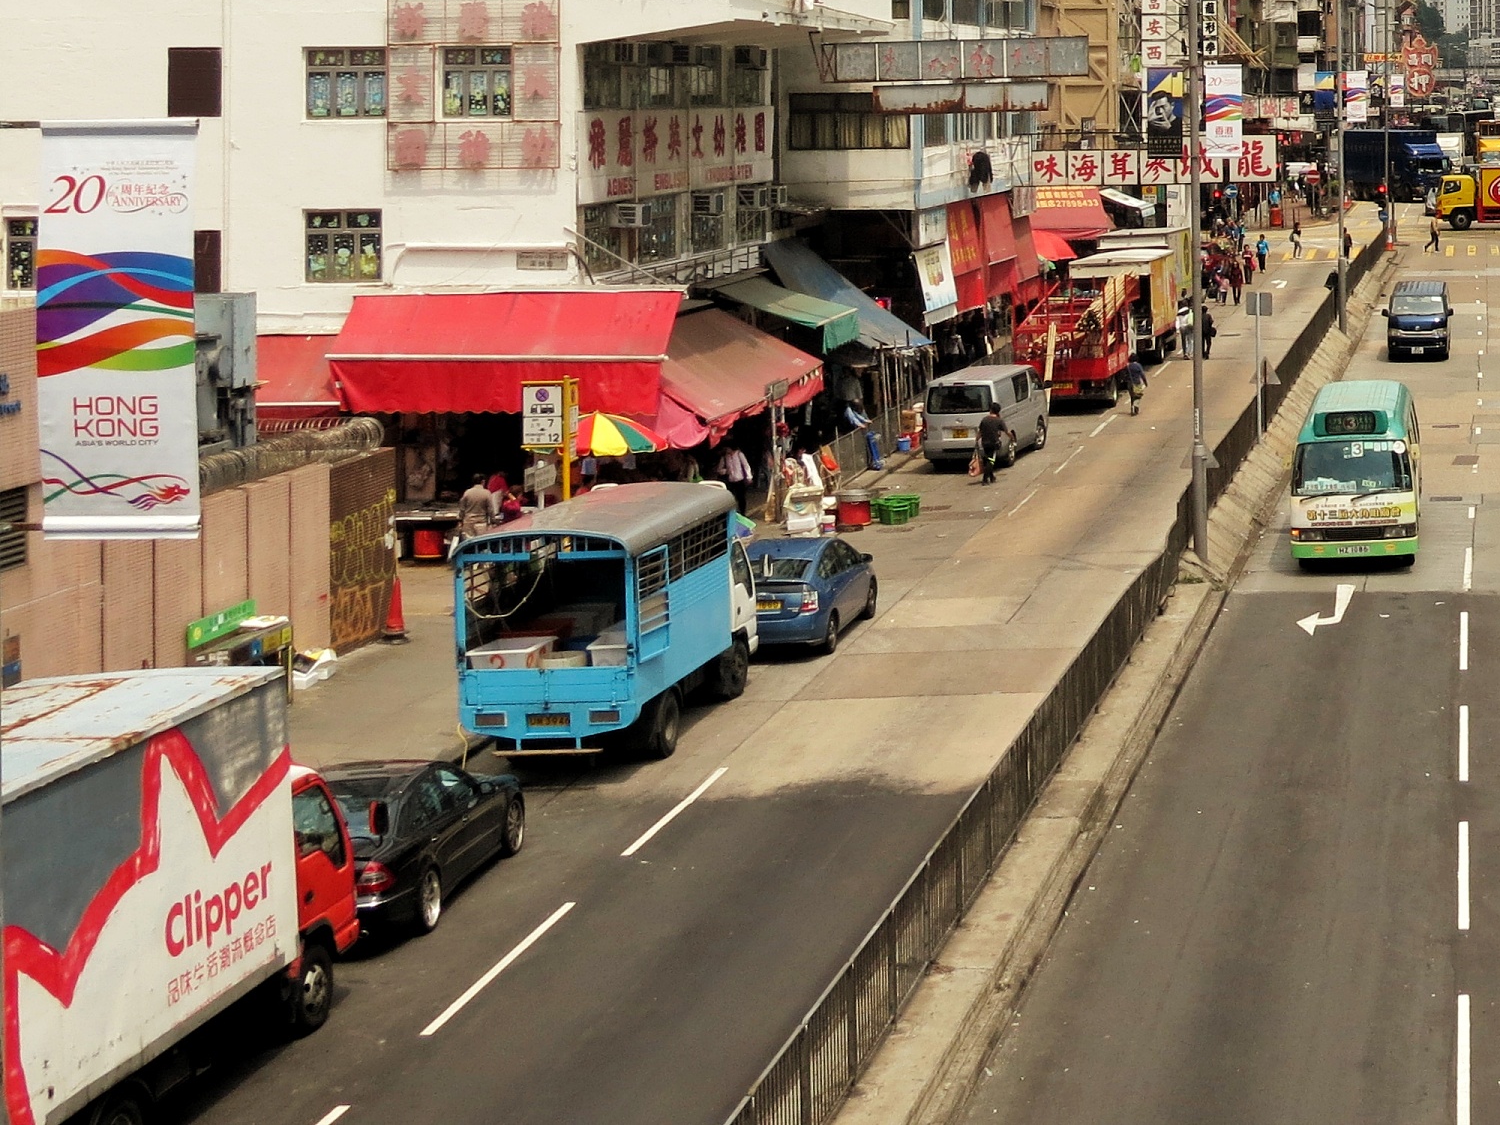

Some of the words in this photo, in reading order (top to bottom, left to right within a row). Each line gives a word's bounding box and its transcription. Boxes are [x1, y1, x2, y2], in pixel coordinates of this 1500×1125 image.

[121, 183, 170, 196] 周年紀念
[607, 176, 634, 197] AGNES
[43, 174, 106, 214] 20
[112, 195, 183, 207] ANNIVERSARY
[73, 395, 158, 416] HONG
[74, 417, 159, 437] KONG
[547, 418, 554, 427] 7
[75, 439, 104, 447] ASIA'S
[105, 439, 137, 447] WORLD
[548, 433, 560, 443] 12
[1353, 443, 1362, 455] 3
[165, 860, 272, 957] Clipper
